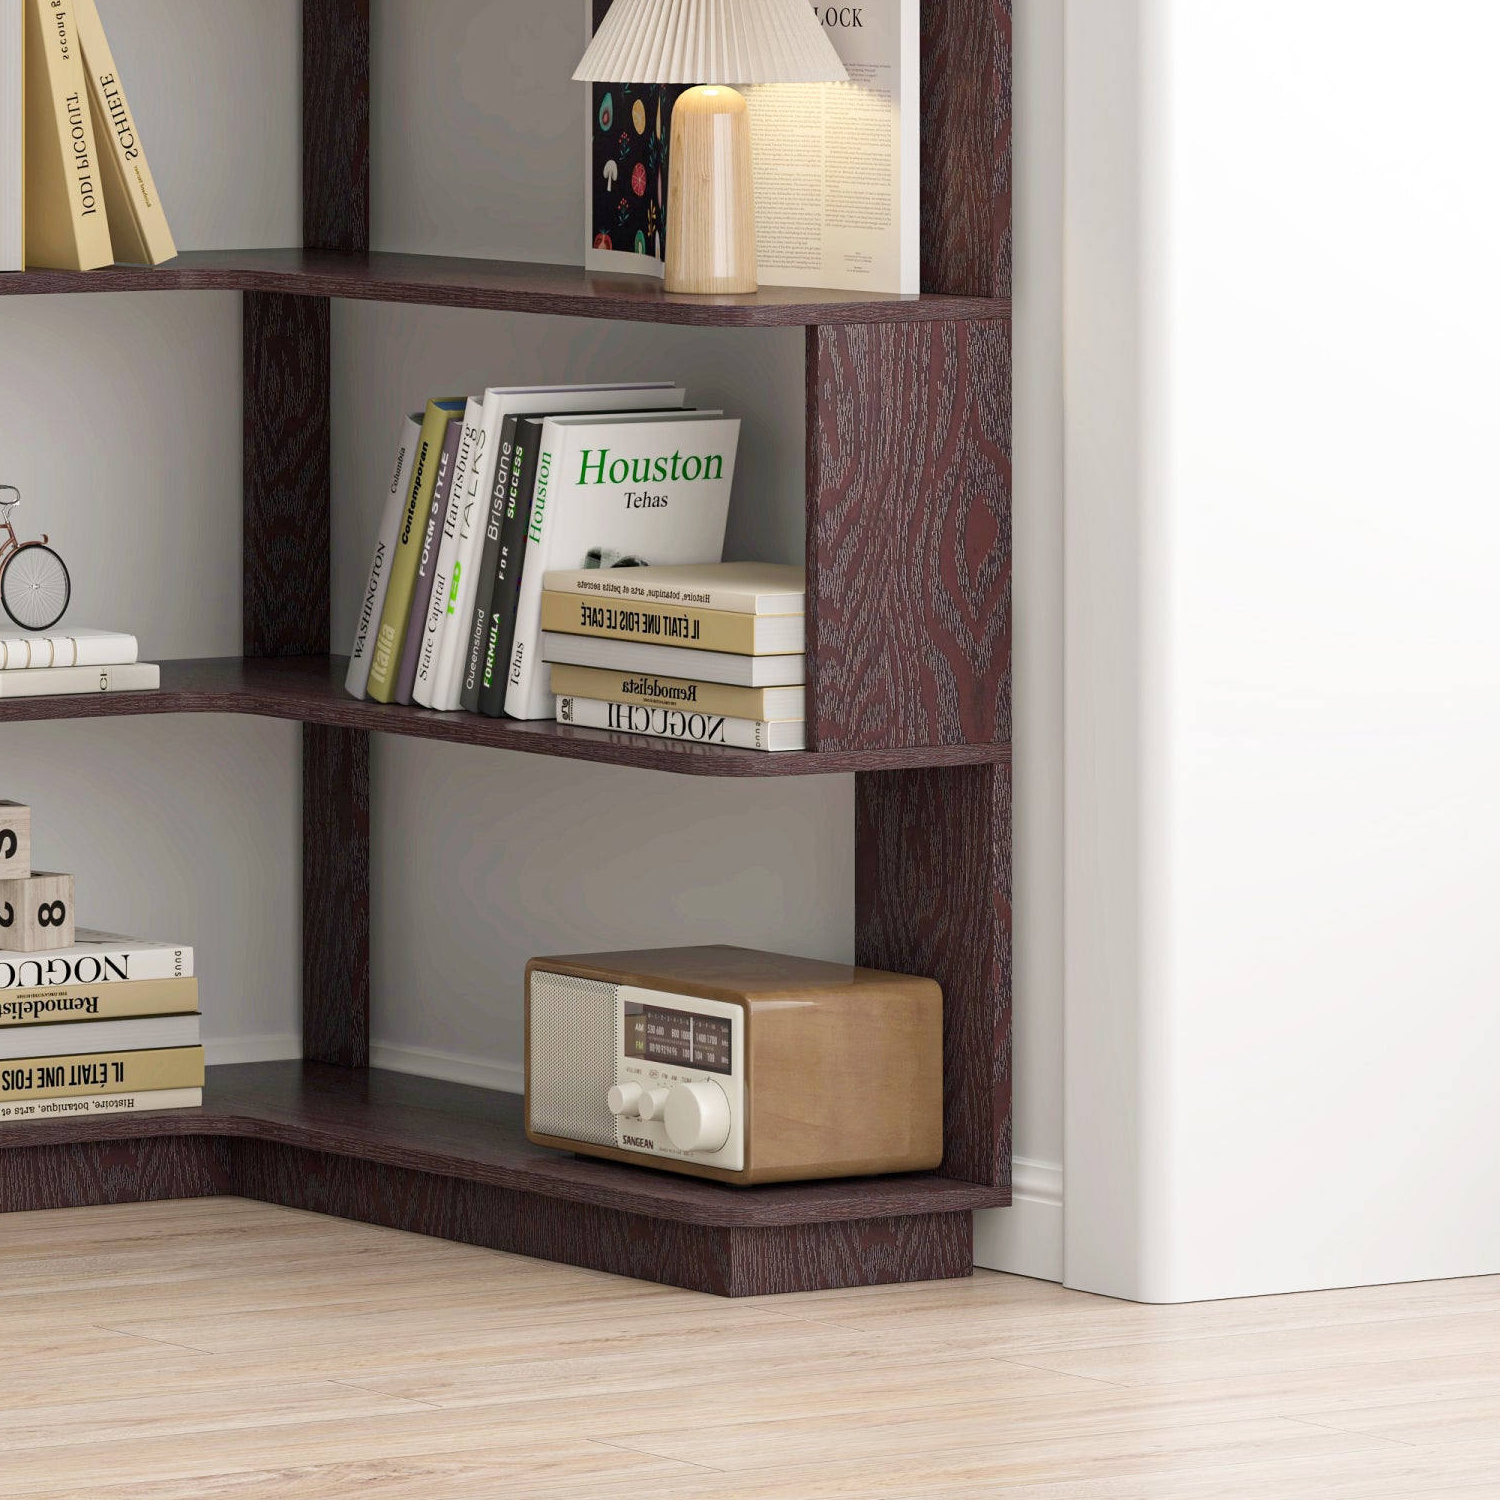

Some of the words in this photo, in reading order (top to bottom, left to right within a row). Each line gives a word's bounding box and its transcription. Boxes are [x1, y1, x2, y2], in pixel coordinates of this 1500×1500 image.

[401, 441, 429, 545] Contemporan
[419, 521, 435, 577] FORM
[431, 451, 449, 515] STYLE
[528, 451, 552, 545] Houston
[575, 448, 724, 486] Houston
[624, 491, 668, 509] Tehas
[419, 637, 434, 681] State
[427, 573, 446, 634] Capital
[444, 422, 478, 539] Harrisburg
[466, 607, 485, 690] Queensland
[487, 441, 512, 541] Brisbane
[483, 613, 500, 688] FORMULA
[507, 445, 523, 519] SUCCESS
[354, 540, 386, 660] WASHINGTON
[510, 641, 524, 687] Tehas
[635, 1023, 644, 1033] AM
[635, 1040, 644, 1049] FM
[622, 1134, 654, 1150] SANGEAN
